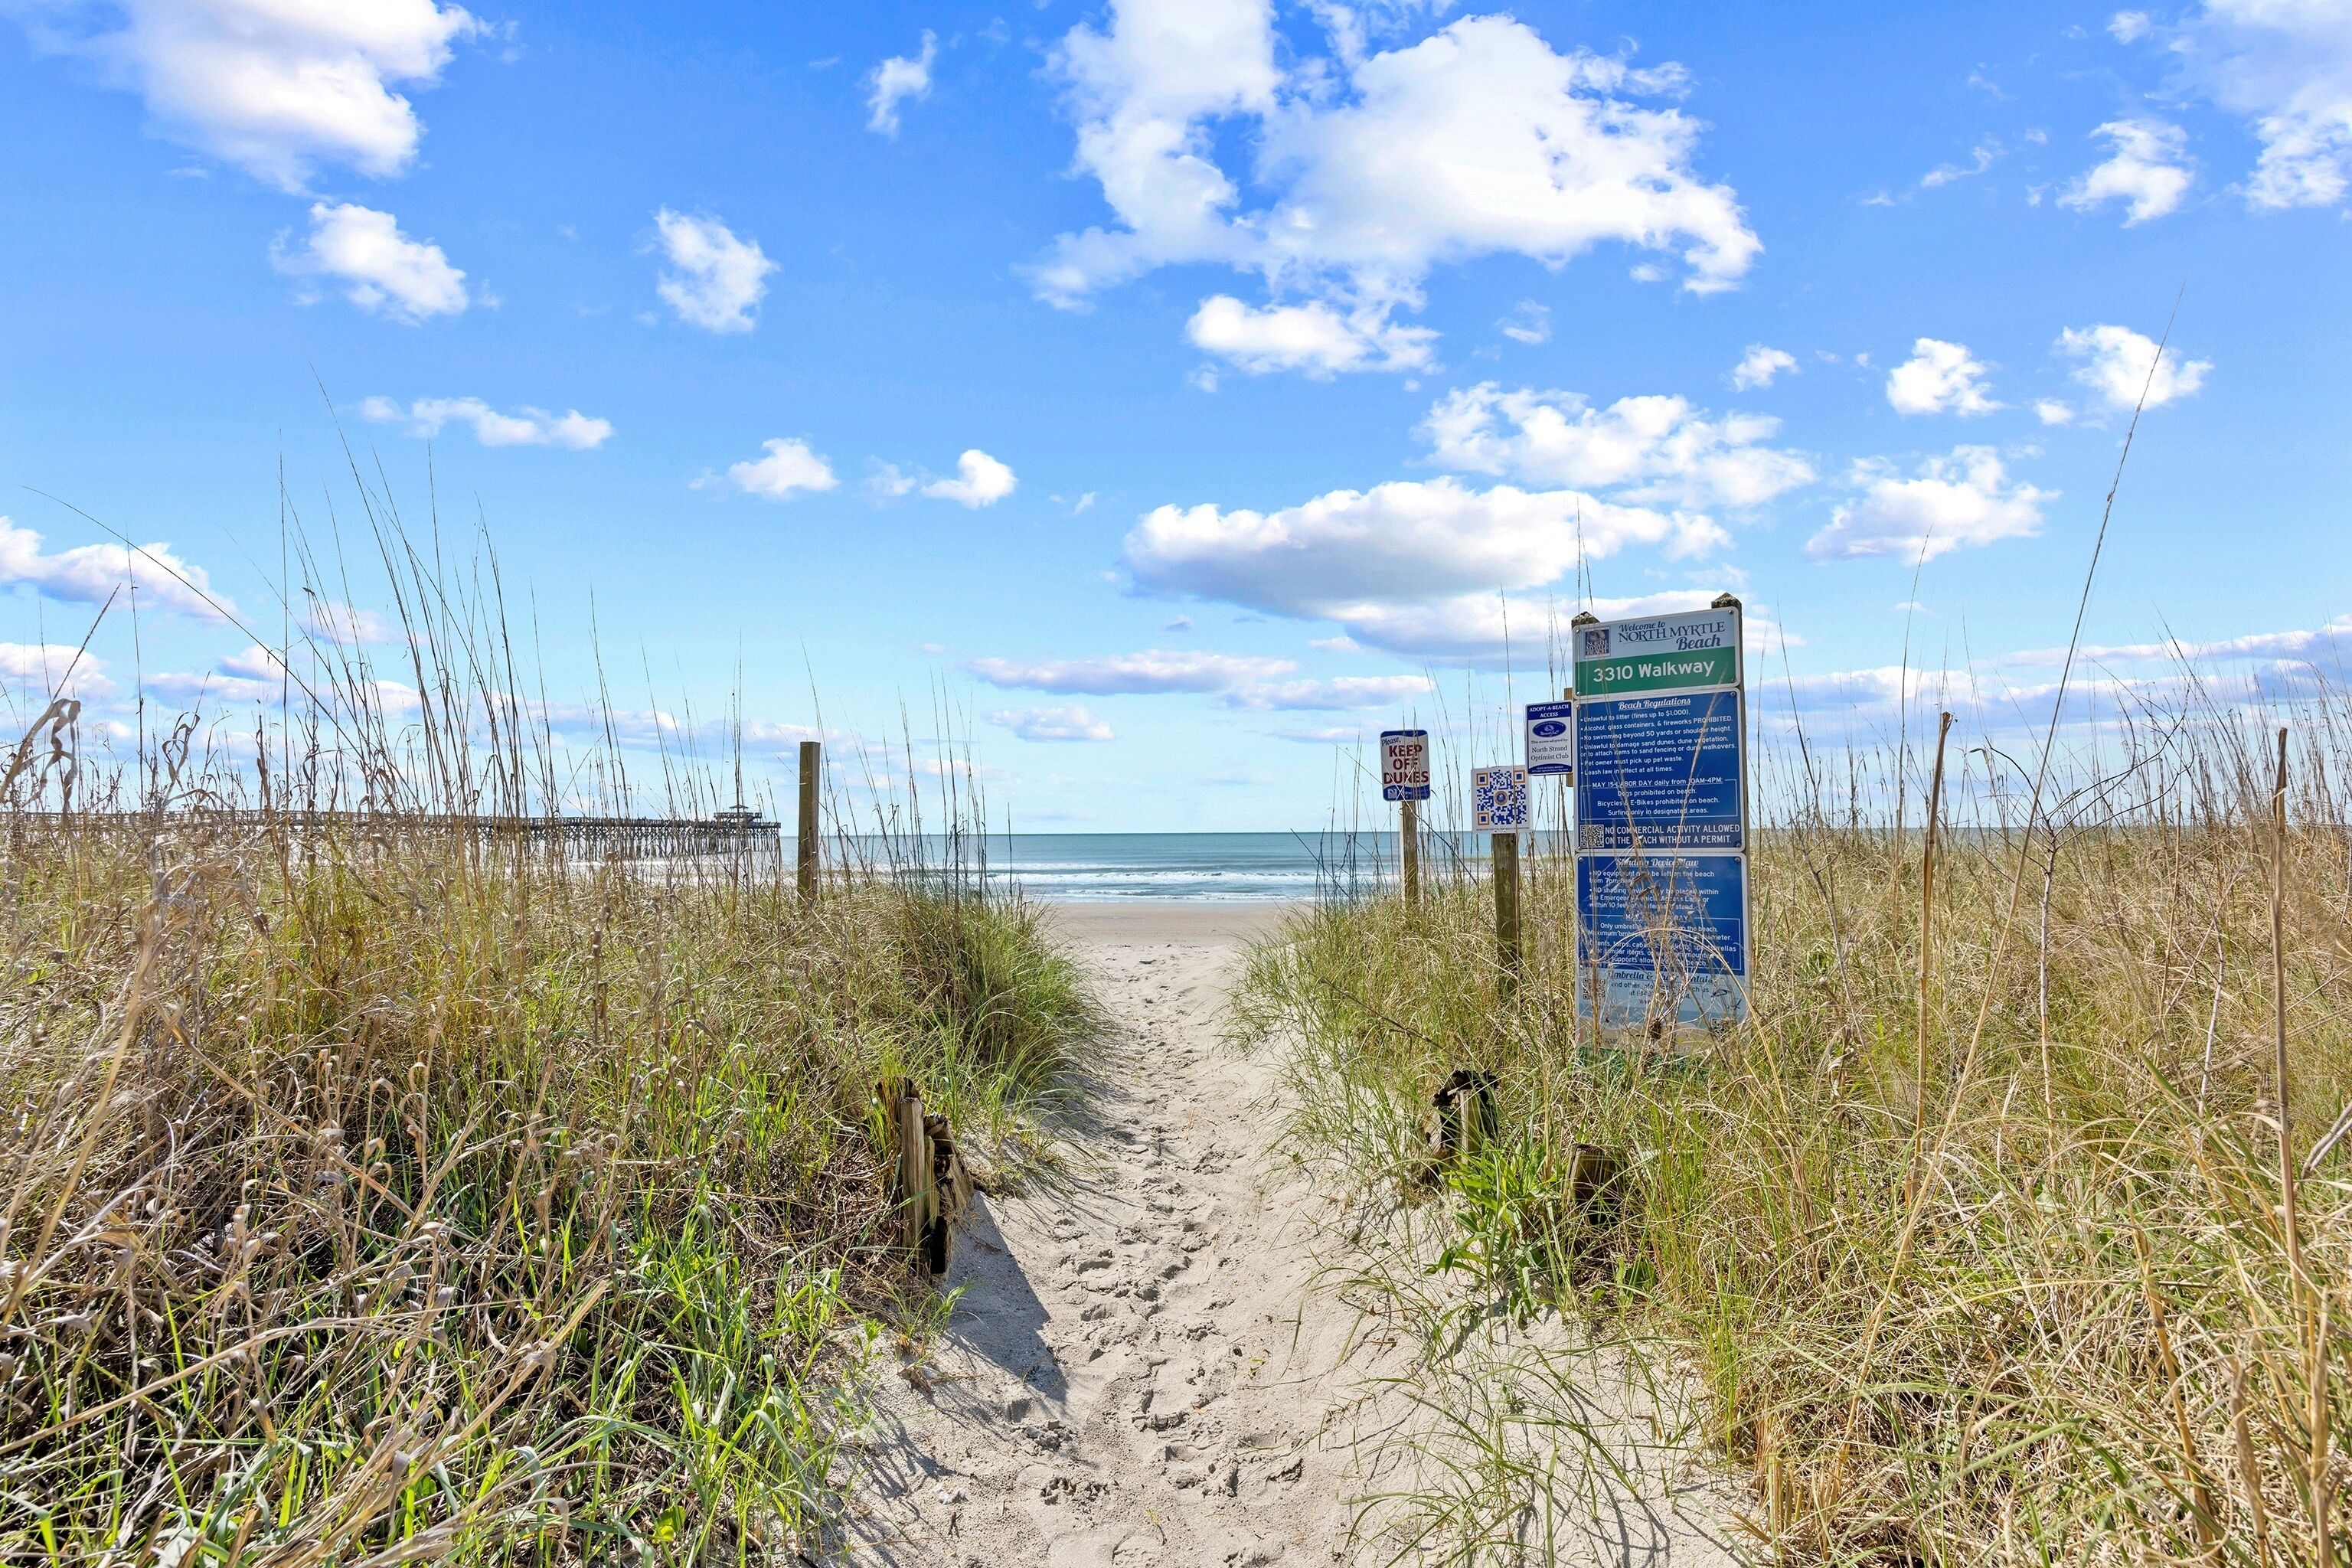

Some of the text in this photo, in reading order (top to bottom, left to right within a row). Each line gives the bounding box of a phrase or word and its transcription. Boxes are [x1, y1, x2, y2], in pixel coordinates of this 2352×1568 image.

[1619, 622, 1656, 632] Welcome
[1619, 621, 1725, 643] NORTH MYRTLE
[1676, 634, 1721, 650] Beach
[1593, 660, 1715, 682] 3310 Walkway
[1618, 698, 1691, 710] Beach Regulations
[1382, 737, 1401, 746] Please,
[1389, 745, 1422, 757] KEEP
[1393, 758, 1418, 770] OFF
[1383, 771, 1429, 784] DUNES
[1667, 825, 1700, 833] ACTIVITY
[1703, 824, 1740, 832] ALLOWED
[1633, 836, 1657, 844] BACH
[1646, 971, 1653, 980] &
